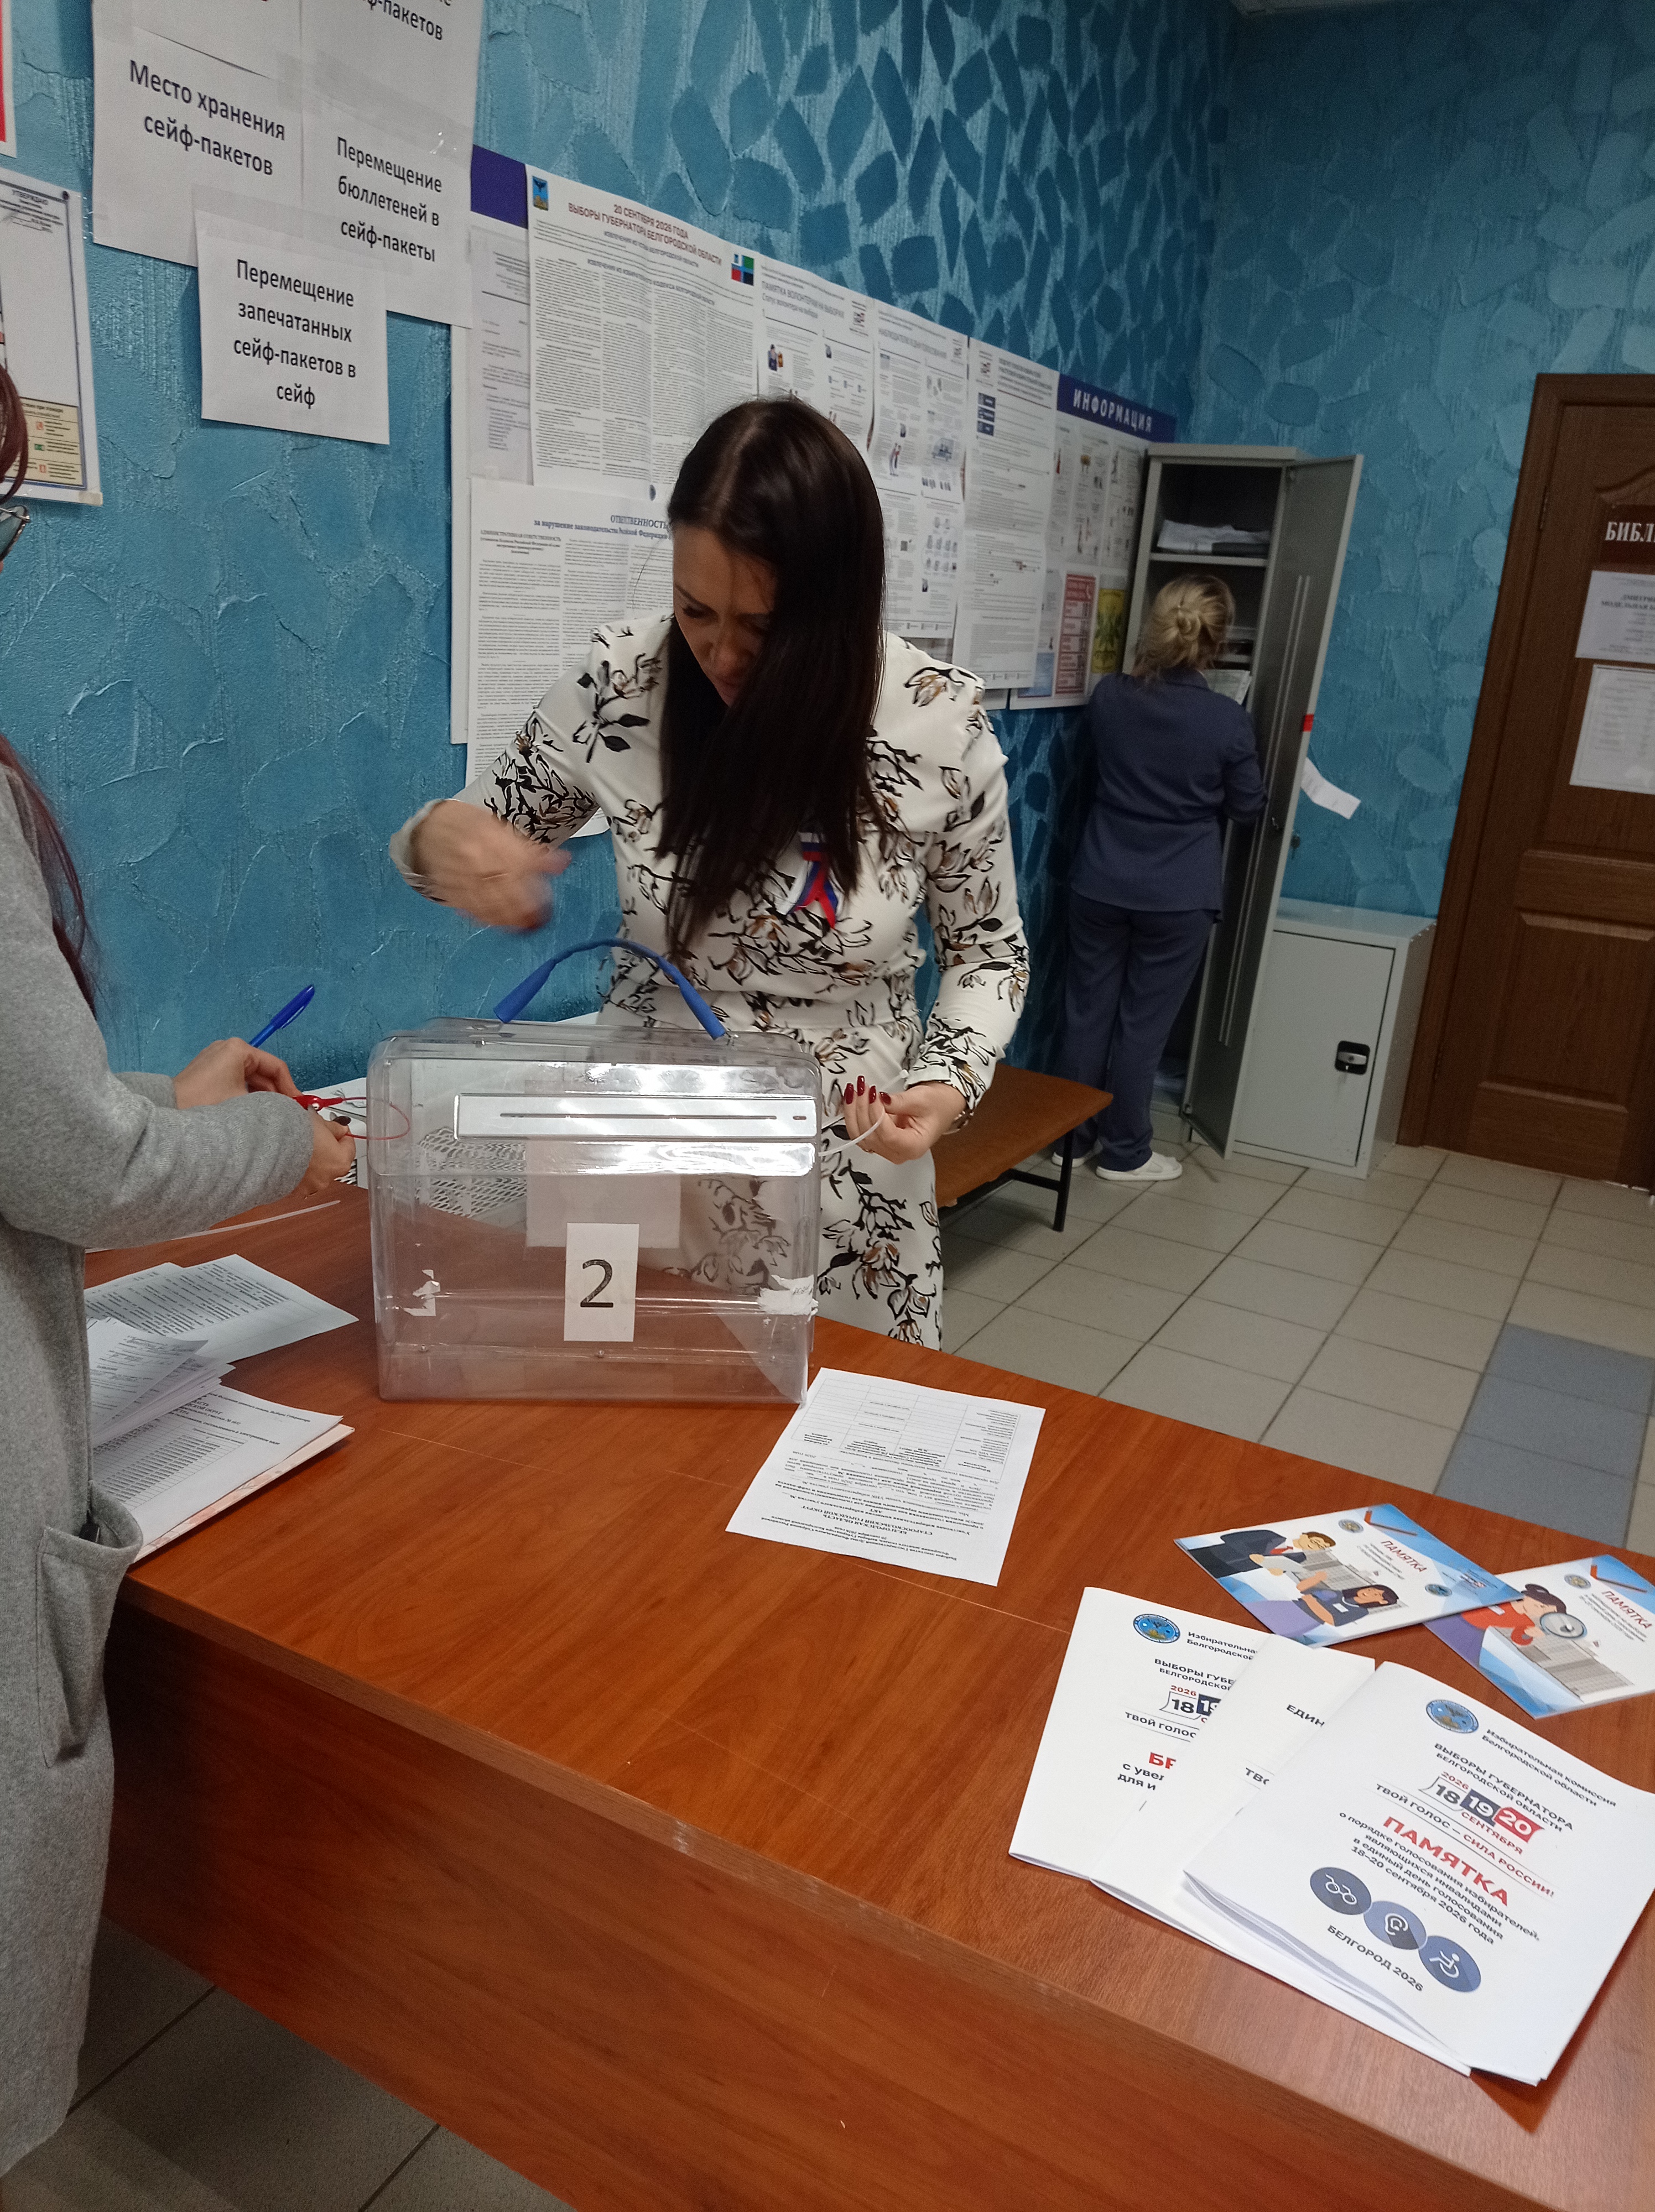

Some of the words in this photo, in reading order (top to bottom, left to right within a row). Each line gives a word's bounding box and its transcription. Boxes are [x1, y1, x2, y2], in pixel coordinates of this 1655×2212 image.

[366, 0, 443, 40] ф-пакетов
[130, 59, 192, 104] Место
[197, 92, 285, 140] хранения
[144, 116, 273, 175] сейф-пакетов
[337, 136, 442, 193] Перемещение
[338, 175, 427, 223] бюллетеней
[432, 212, 440, 226] в
[569, 202, 601, 221] ВЫБОРЫ
[341, 221, 435, 262] сейф-пакеты
[237, 259, 354, 307] Перемещение
[238, 302, 352, 342] запечатанных
[234, 337, 343, 376] сейф-пакетов
[348, 364, 356, 378] в
[277, 383, 315, 410] сейф
[1073, 389, 1152, 432] ИНФОРМАЦИЯ
[1605, 521, 1655, 542] БИБЛ
[580, 1258, 614, 1308] 2
[1381, 1540, 1427, 1572] ПАМЯТКА
[1602, 1590, 1652, 1629] ПАМЯТКА
[1188, 1631, 1258, 1654] Избирательна
[1154, 1658, 1204, 1677] ВЫБОРЫ
[1207, 1673, 1236, 1686] ГУБЕ
[1170, 1685, 1196, 1697] 2026
[1125, 1711, 1156, 1727] ТВОЙ
[1172, 1698, 1194, 1714] 18
[1287, 1704, 1325, 1728] ЕДИН
[1117, 1774, 1144, 1787] для
[1434, 1743, 1486, 1775] ВЫБОРЫ
[1489, 1773, 1573, 1830] ГУБЕРНАТОРА
[1441, 1771, 1469, 1790] 2026
[1482, 1735, 1553, 1781] Белгородской
[1554, 1779, 1597, 1807] области
[1487, 1729, 1563, 1776] Избирательная
[1565, 1776, 1616, 1807] комиссия
[1435, 1785, 1461, 1806] 18
[1468, 1794, 1494, 1817] 19
[1499, 1810, 1532, 1835] 20
[1437, 1753, 1513, 1801] БЕЛГОРОДСКОЙ
[1515, 1799, 1562, 1832] ОБЛАСТИ
[1376, 1783, 1408, 1804] ТВОЙ
[1410, 1802, 1451, 1829] ГОЛОС
[1463, 1834, 1495, 1860] СИЛА
[1499, 1858, 1555, 1897] РОССИИ!
[1461, 1812, 1523, 1854] СЕНТЯБРЯ
[1349, 1816, 1393, 1842] порядке
[1394, 1841, 1463, 1889] голосования
[1465, 1886, 1540, 1941] избирателей,
[1365, 1834, 1433, 1879] являющихся
[1435, 1875, 1502, 1927] инвалидами
[1383, 1816, 1507, 1906] ПАМЯТКА
[1362, 1841, 1403, 1870] единый
[1404, 1867, 1431, 1888] день
[1433, 1886, 1503, 1940] голосования
[1386, 1867, 1437, 1903] сентября
[1438, 1902, 1467, 1924] 2026
[1468, 1922, 1494, 1945] года
[1328, 1924, 1392, 1970] БЕЛГОРОД
[1392, 1967, 1424, 1991] 2026
